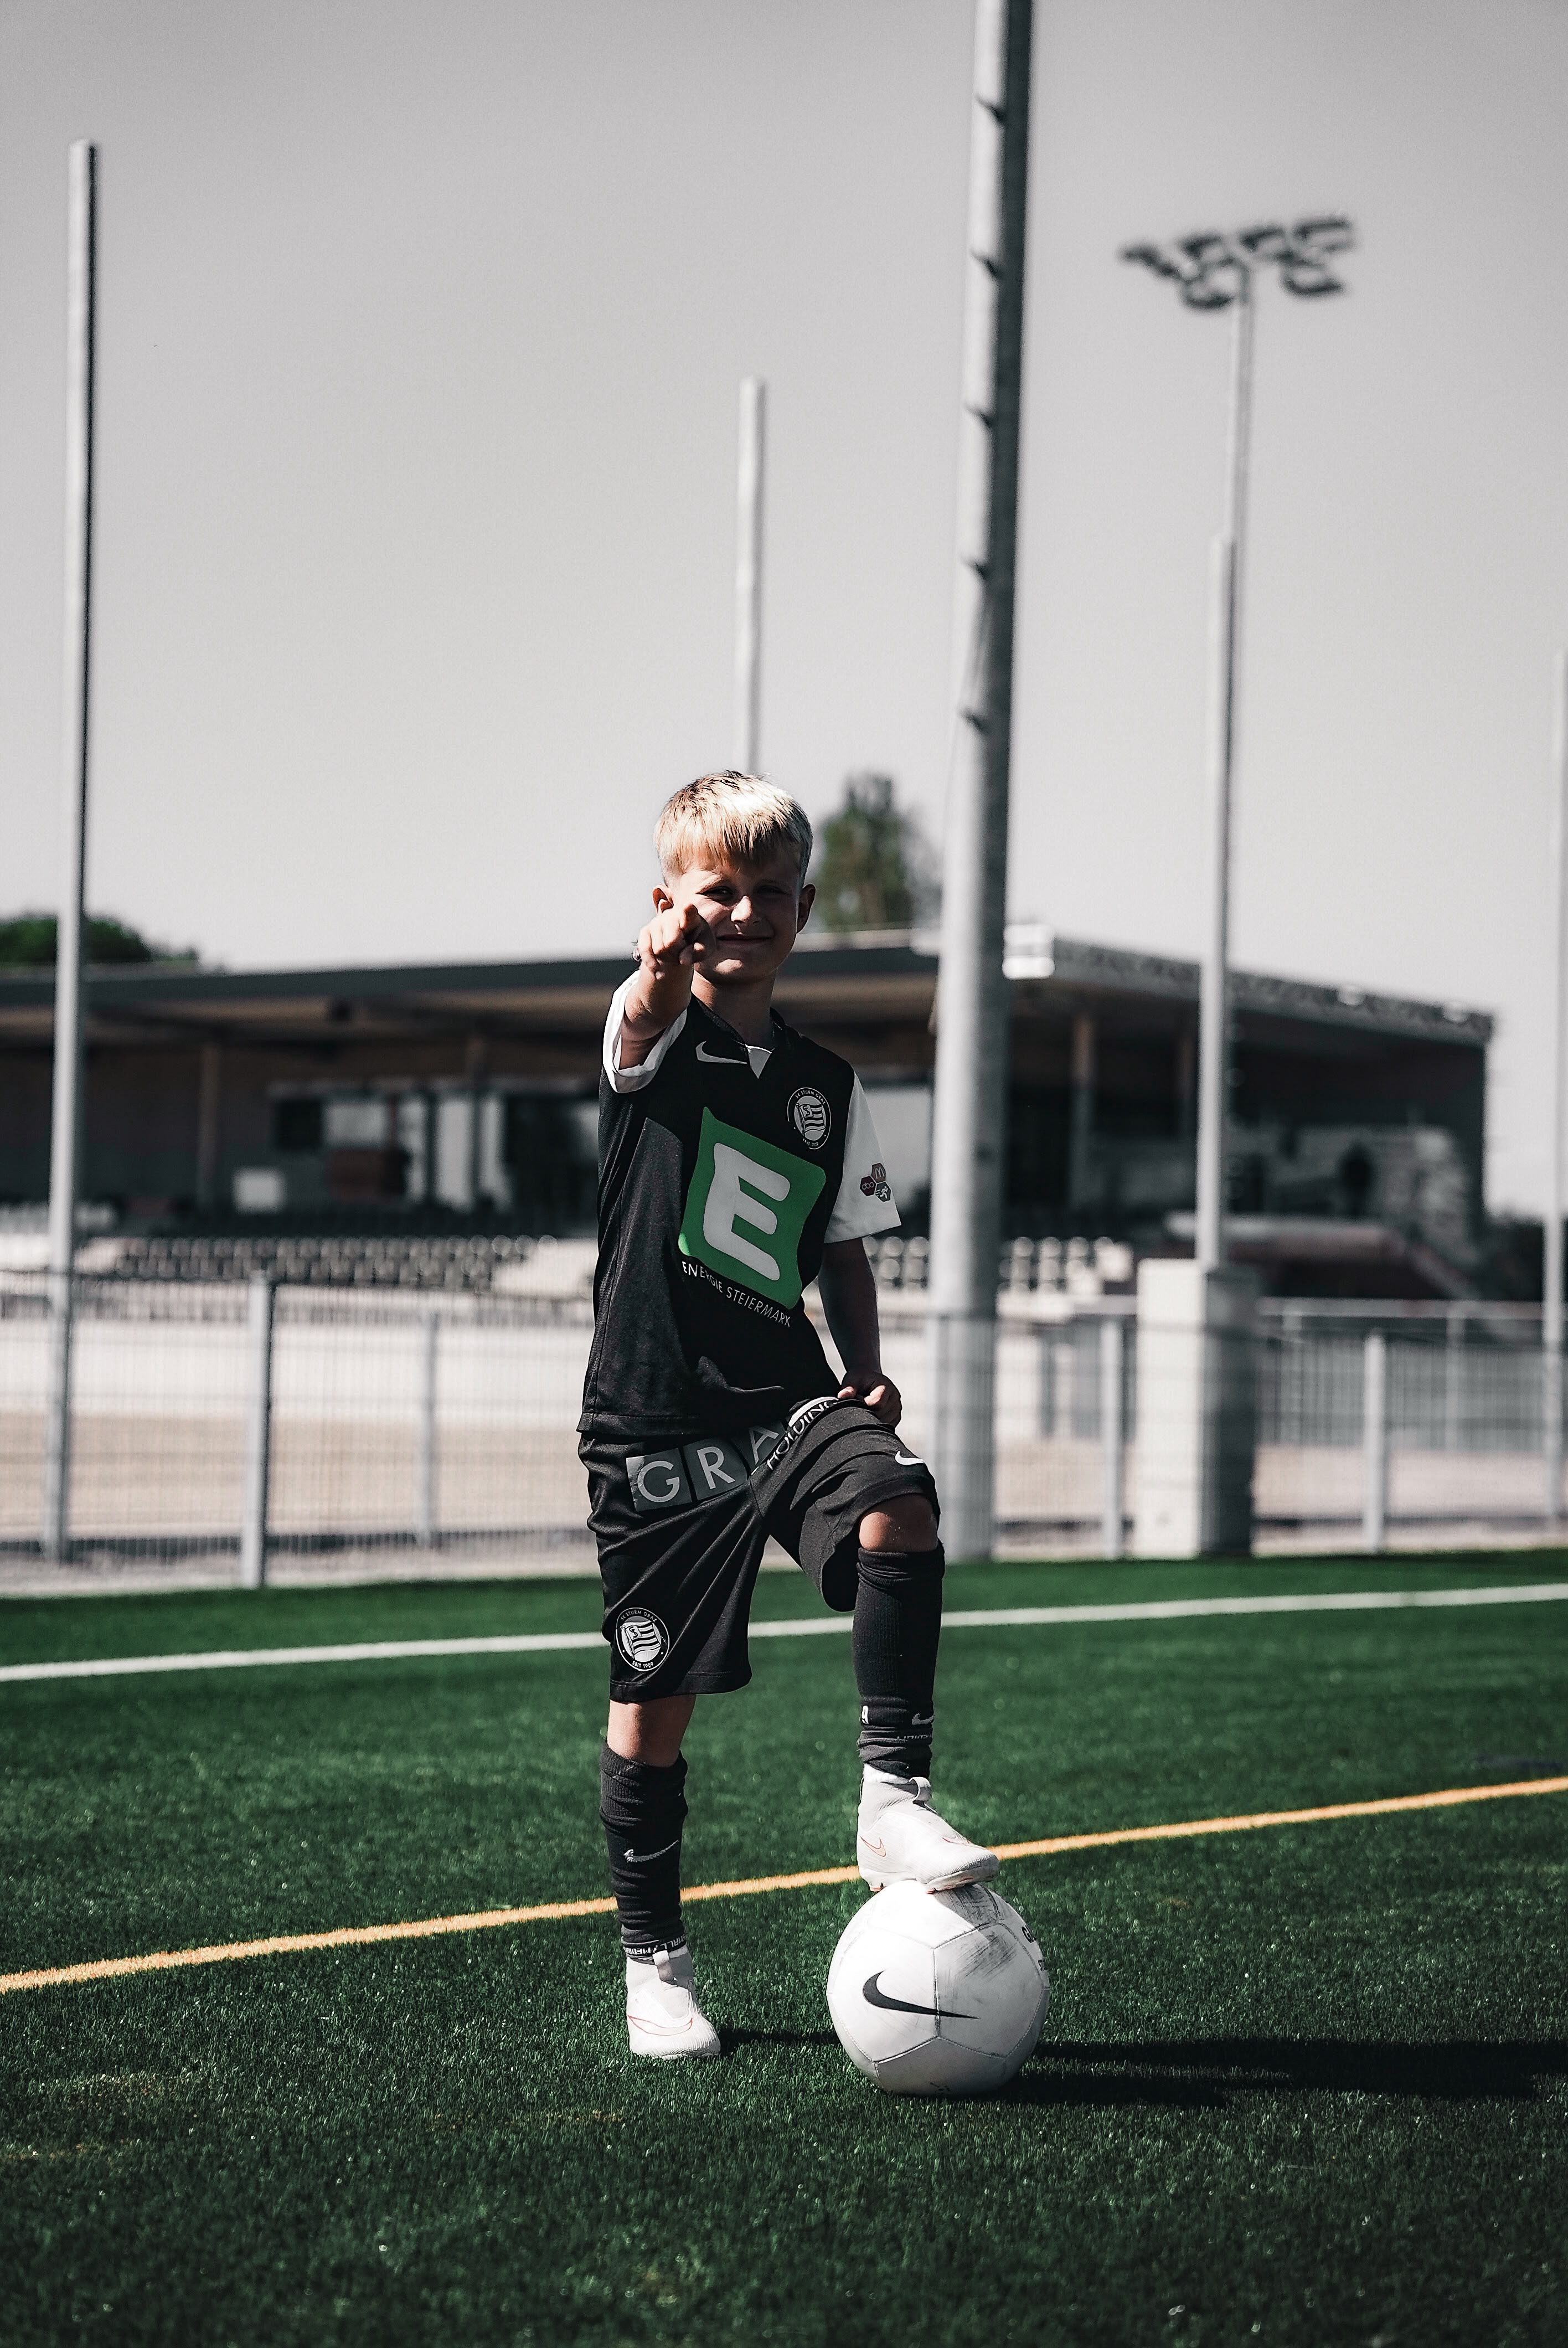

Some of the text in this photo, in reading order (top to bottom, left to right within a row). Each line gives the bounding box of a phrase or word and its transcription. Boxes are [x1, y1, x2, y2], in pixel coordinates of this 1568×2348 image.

[703, 1142, 790, 1280] E
[682, 1261, 791, 1327] ENERGIE STEIERMARK
